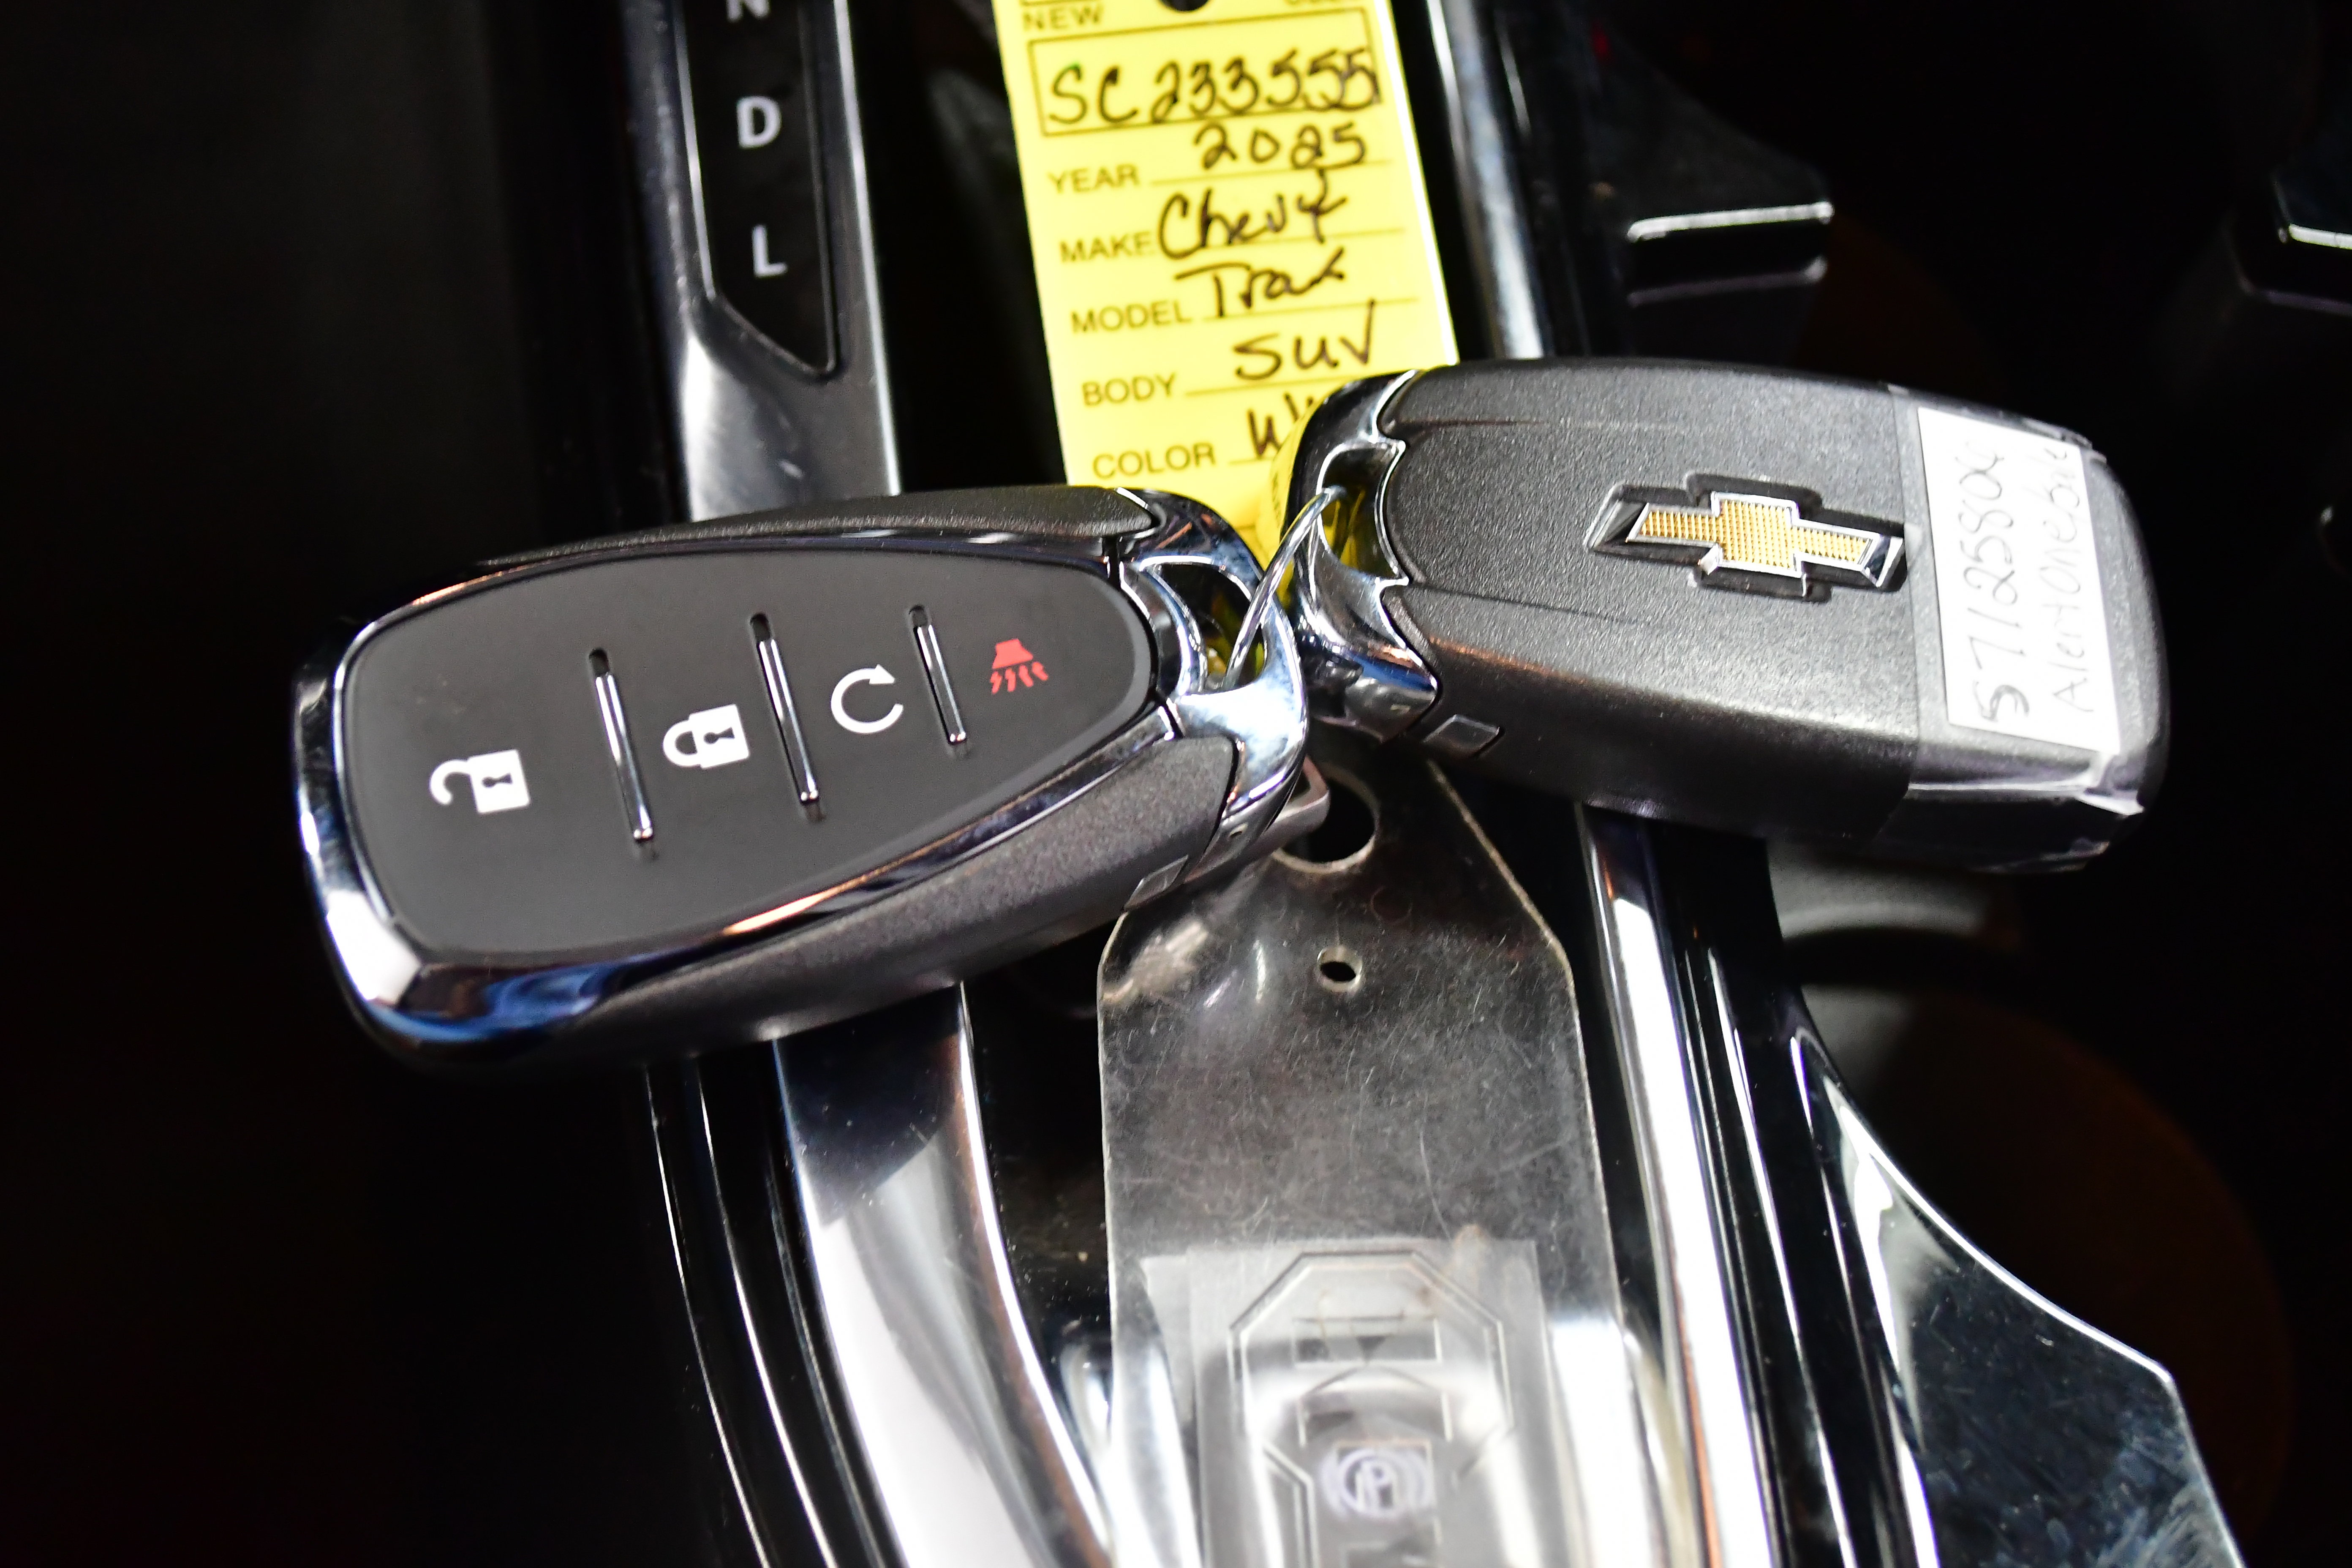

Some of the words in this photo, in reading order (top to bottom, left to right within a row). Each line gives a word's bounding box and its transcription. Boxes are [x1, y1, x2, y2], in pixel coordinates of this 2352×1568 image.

[1023, 5, 1103, 31] NEW
[736, 95, 782, 149] D
[1194, 121, 1366, 170] 2025
[1048, 164, 1140, 194] YEAR
[751, 225, 788, 278] L
[1060, 231, 1153, 263] MAKE
[1070, 300, 1191, 334] MODEL
[1082, 373, 1176, 406] BODY
[1092, 442, 1215, 480] COLOR
